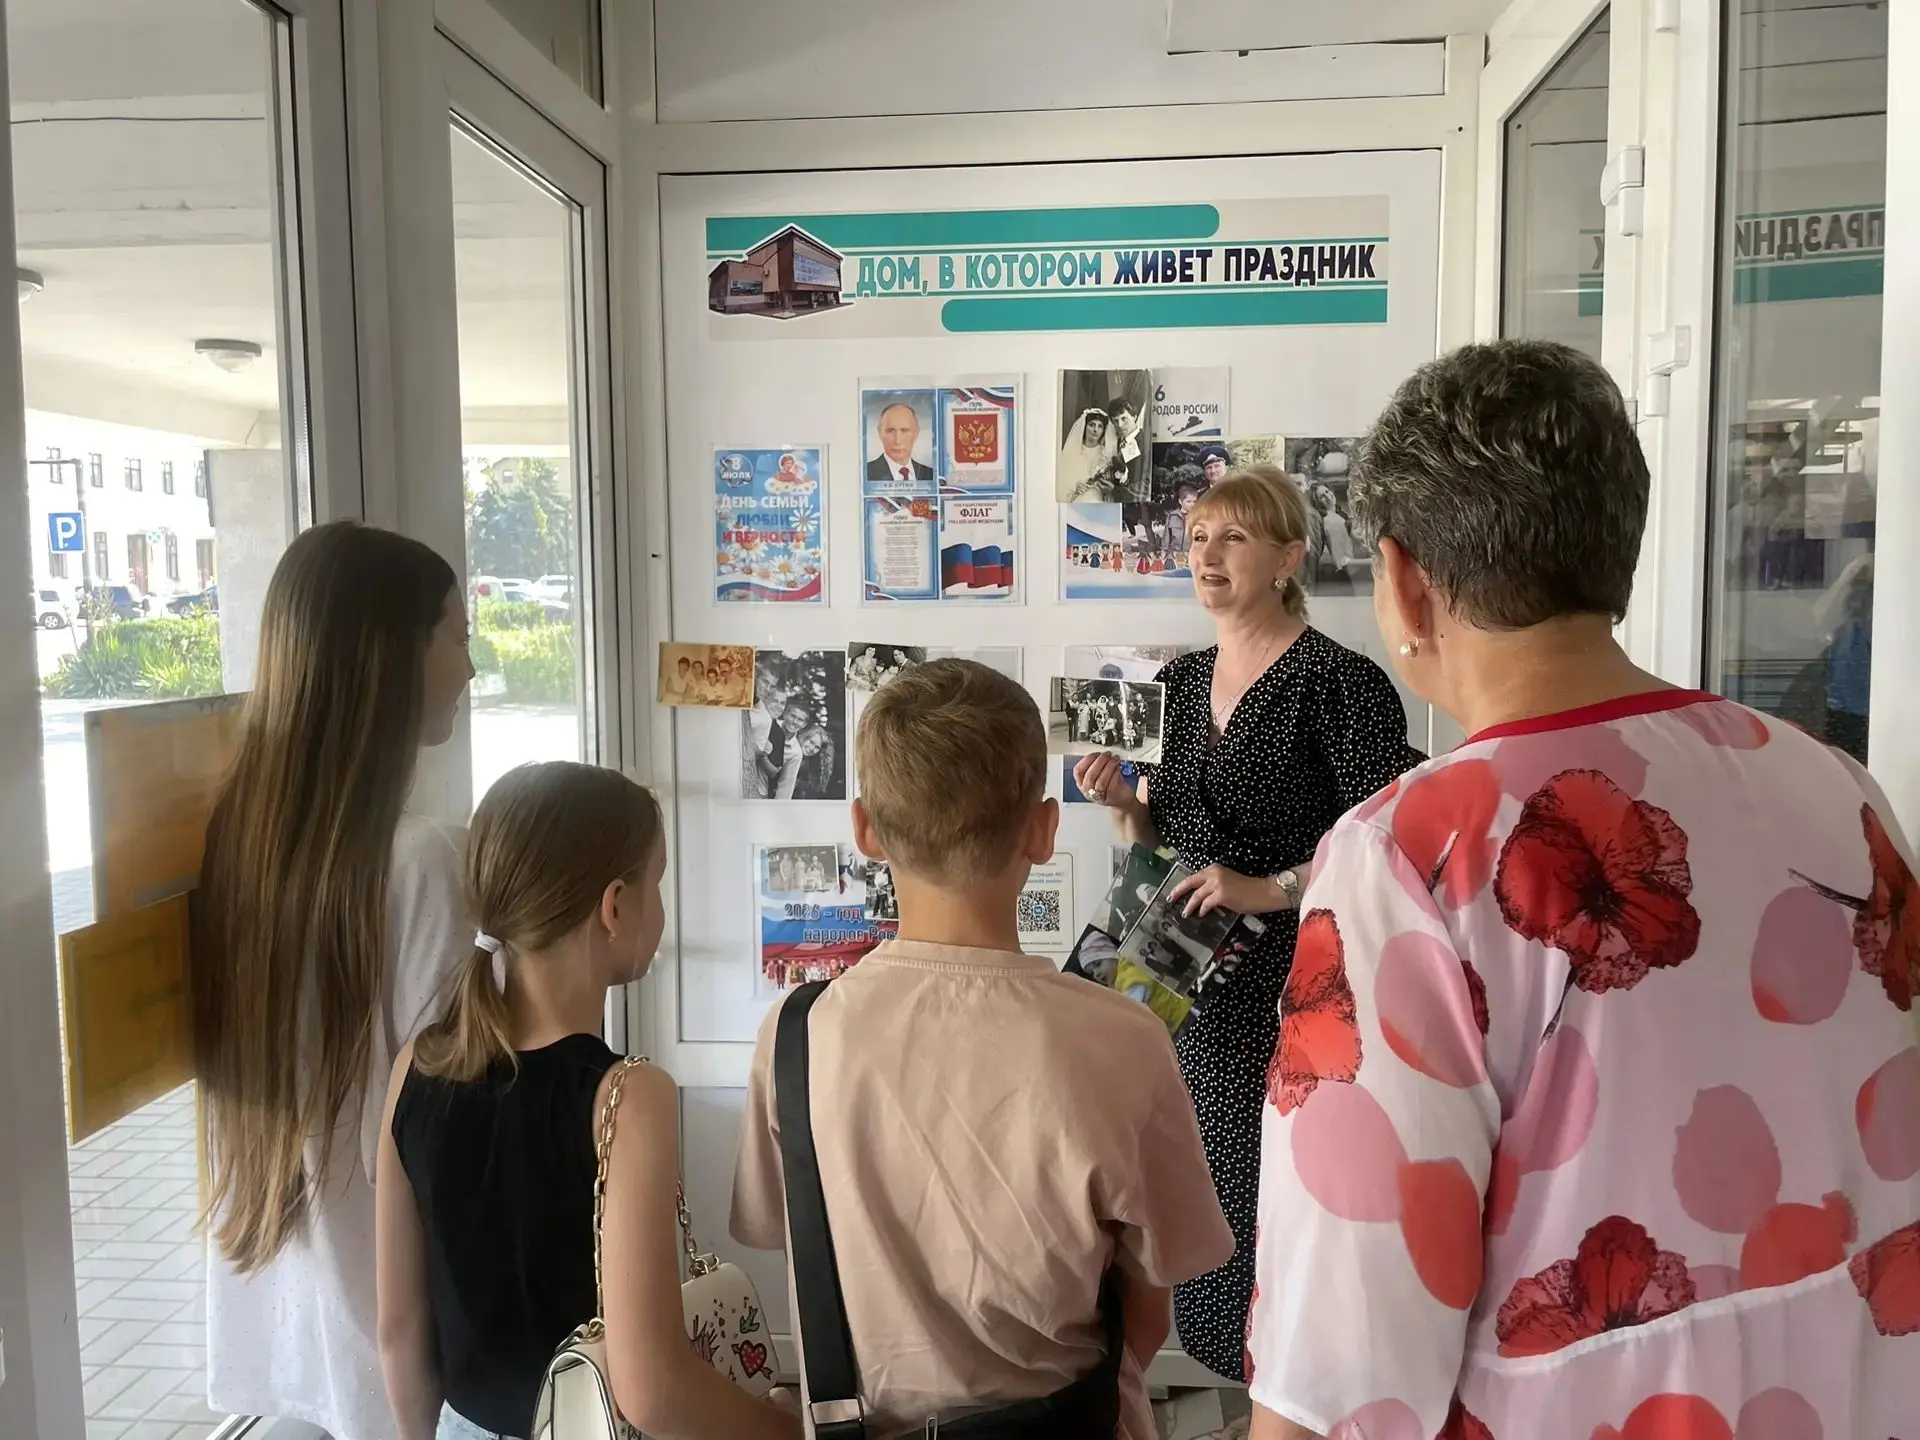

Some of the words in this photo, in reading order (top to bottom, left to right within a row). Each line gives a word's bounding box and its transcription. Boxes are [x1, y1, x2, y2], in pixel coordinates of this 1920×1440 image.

[856, 256, 928, 297] ДОМ,
[938, 257, 955, 290] В
[965, 251, 1102, 289] КОТОРОМ
[1113, 249, 1214, 285] ЖИВЕТ
[1223, 243, 1377, 286] ПРАЗДНИК
[1183, 403, 1219, 415] РОССИИ
[720, 495, 758, 509] ДЕНЬ
[960, 506, 992, 518] ФЛАГ
[56, 517, 77, 549] P
[735, 530, 806, 544] ВЕРНОСТИ
[784, 903, 821, 921] 2026
[835, 906, 863, 923] год
[803, 928, 866, 945] народов
[868, 925, 898, 943] Рос
